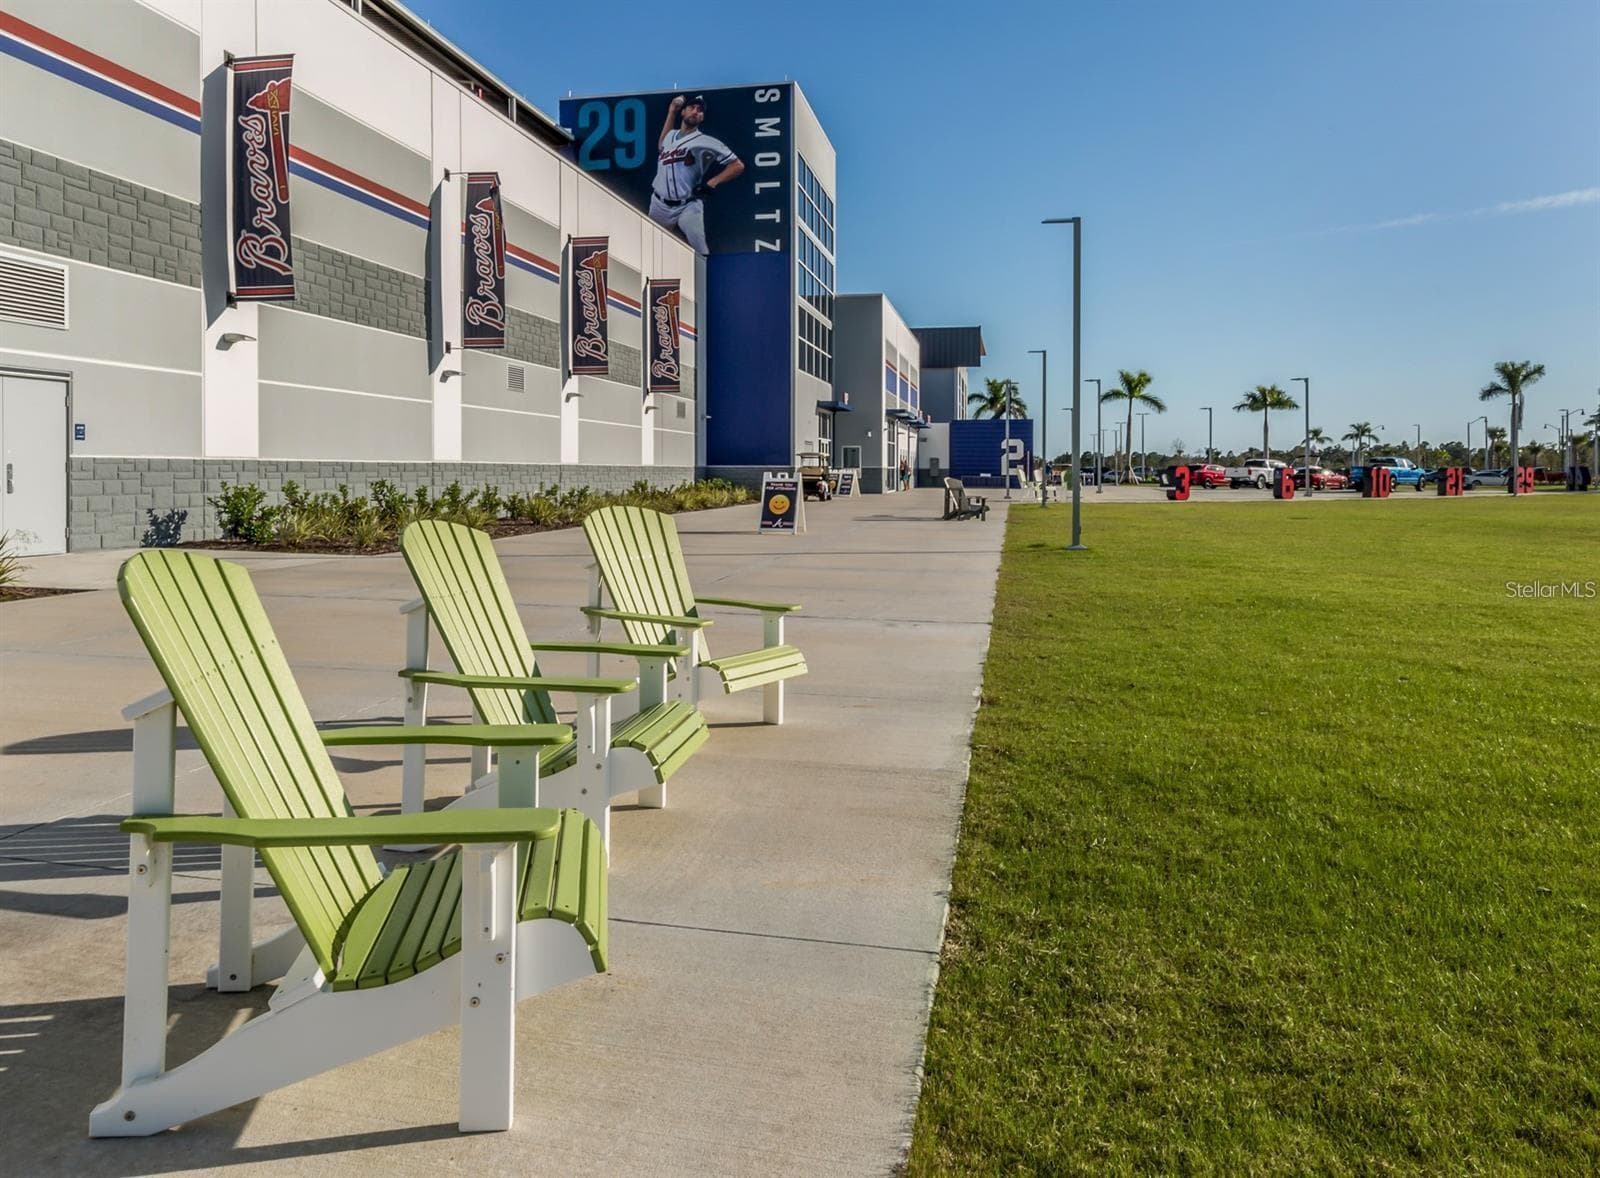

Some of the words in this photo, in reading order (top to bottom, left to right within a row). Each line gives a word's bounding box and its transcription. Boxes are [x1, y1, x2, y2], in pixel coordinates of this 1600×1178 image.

[577, 98, 647, 171] 29
[237, 114, 293, 275] Braves
[755, 88, 780, 252] SMOLTZ
[466, 213, 504, 330] Braves
[574, 270, 608, 360] Braves
[652, 304, 680, 381] Braves
[1001, 439, 1024, 475] 2
[1175, 465, 1190, 500] 3
[1282, 468, 1294, 499] 6
[1370, 468, 1390, 497] 10
[1446, 467, 1463, 495] 21
[1516, 466, 1534, 493] 29
